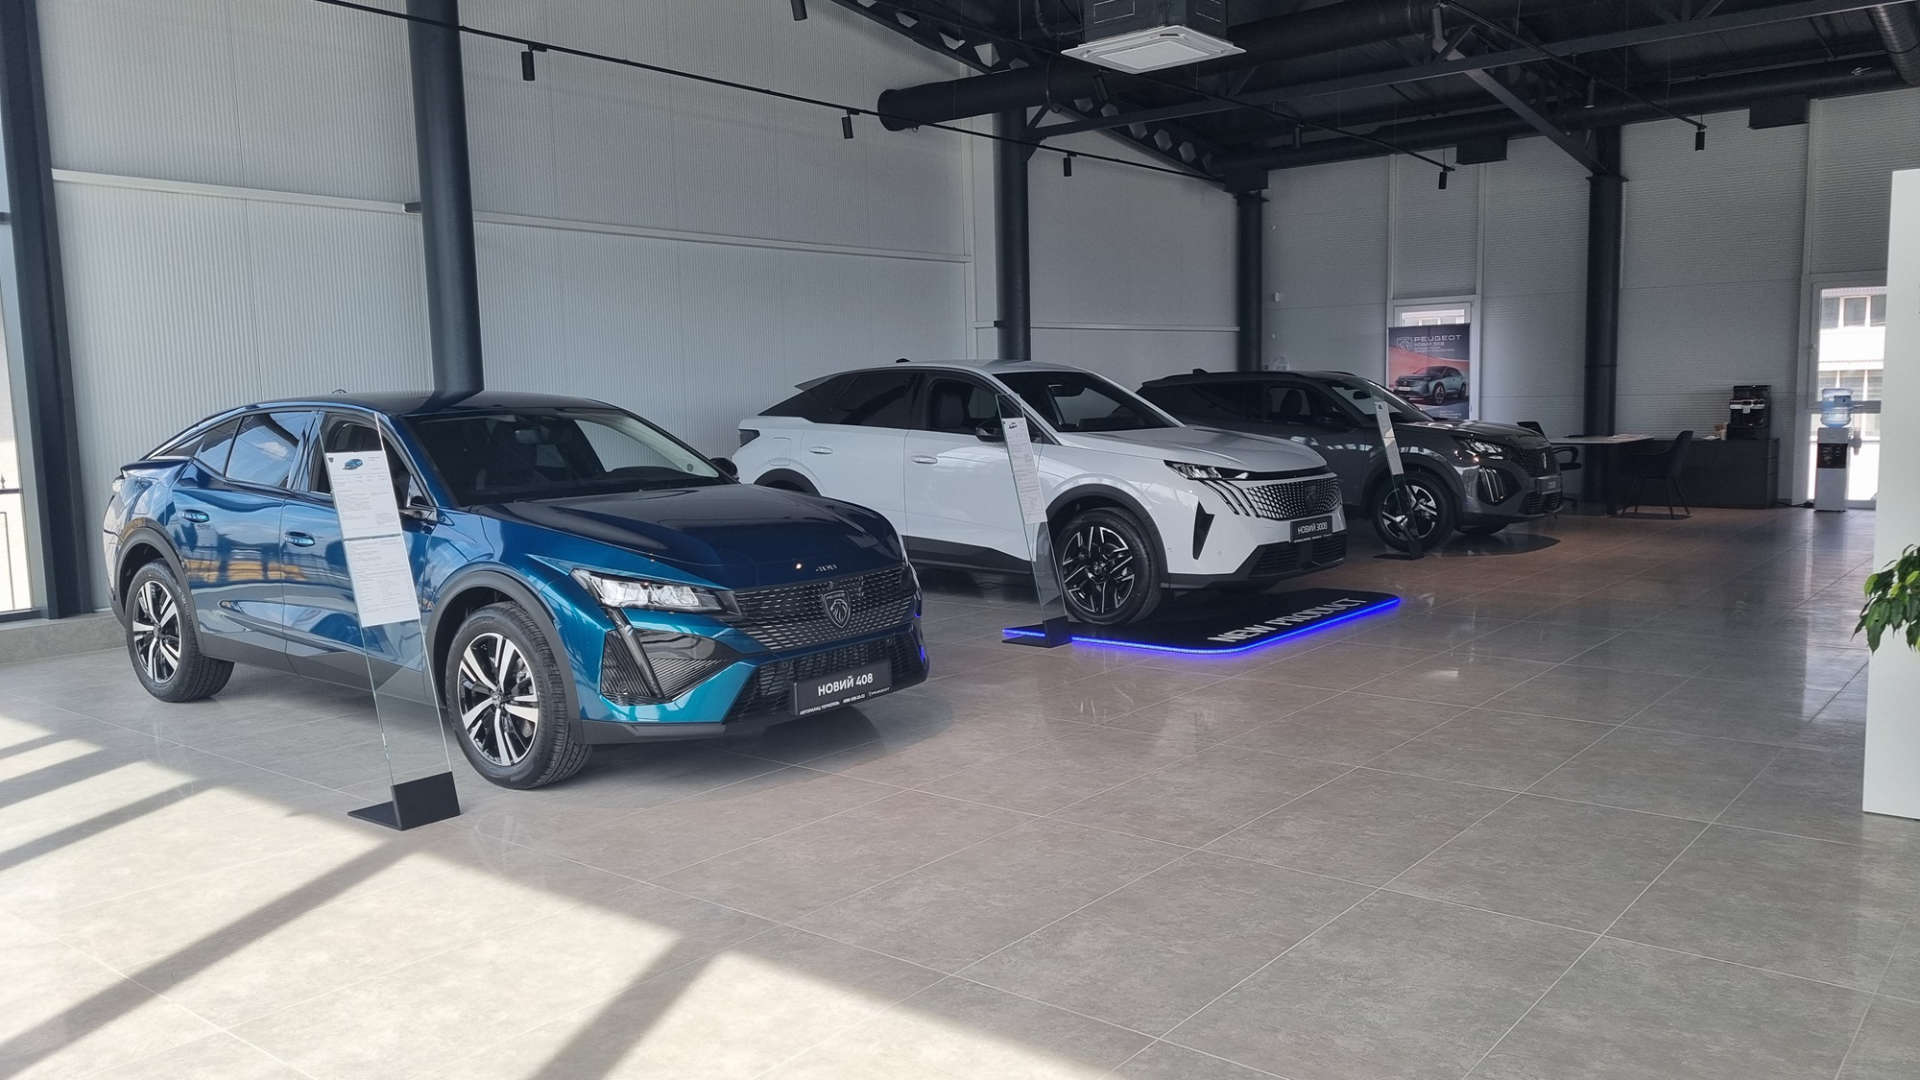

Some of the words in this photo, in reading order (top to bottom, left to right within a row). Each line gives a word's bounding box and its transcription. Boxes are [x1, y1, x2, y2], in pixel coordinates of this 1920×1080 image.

[1207, 624, 1277, 642] NEW
[1264, 598, 1367, 626] PRODUCT
[817, 676, 854, 697] НОВИЙ
[855, 673, 874, 685] 408
